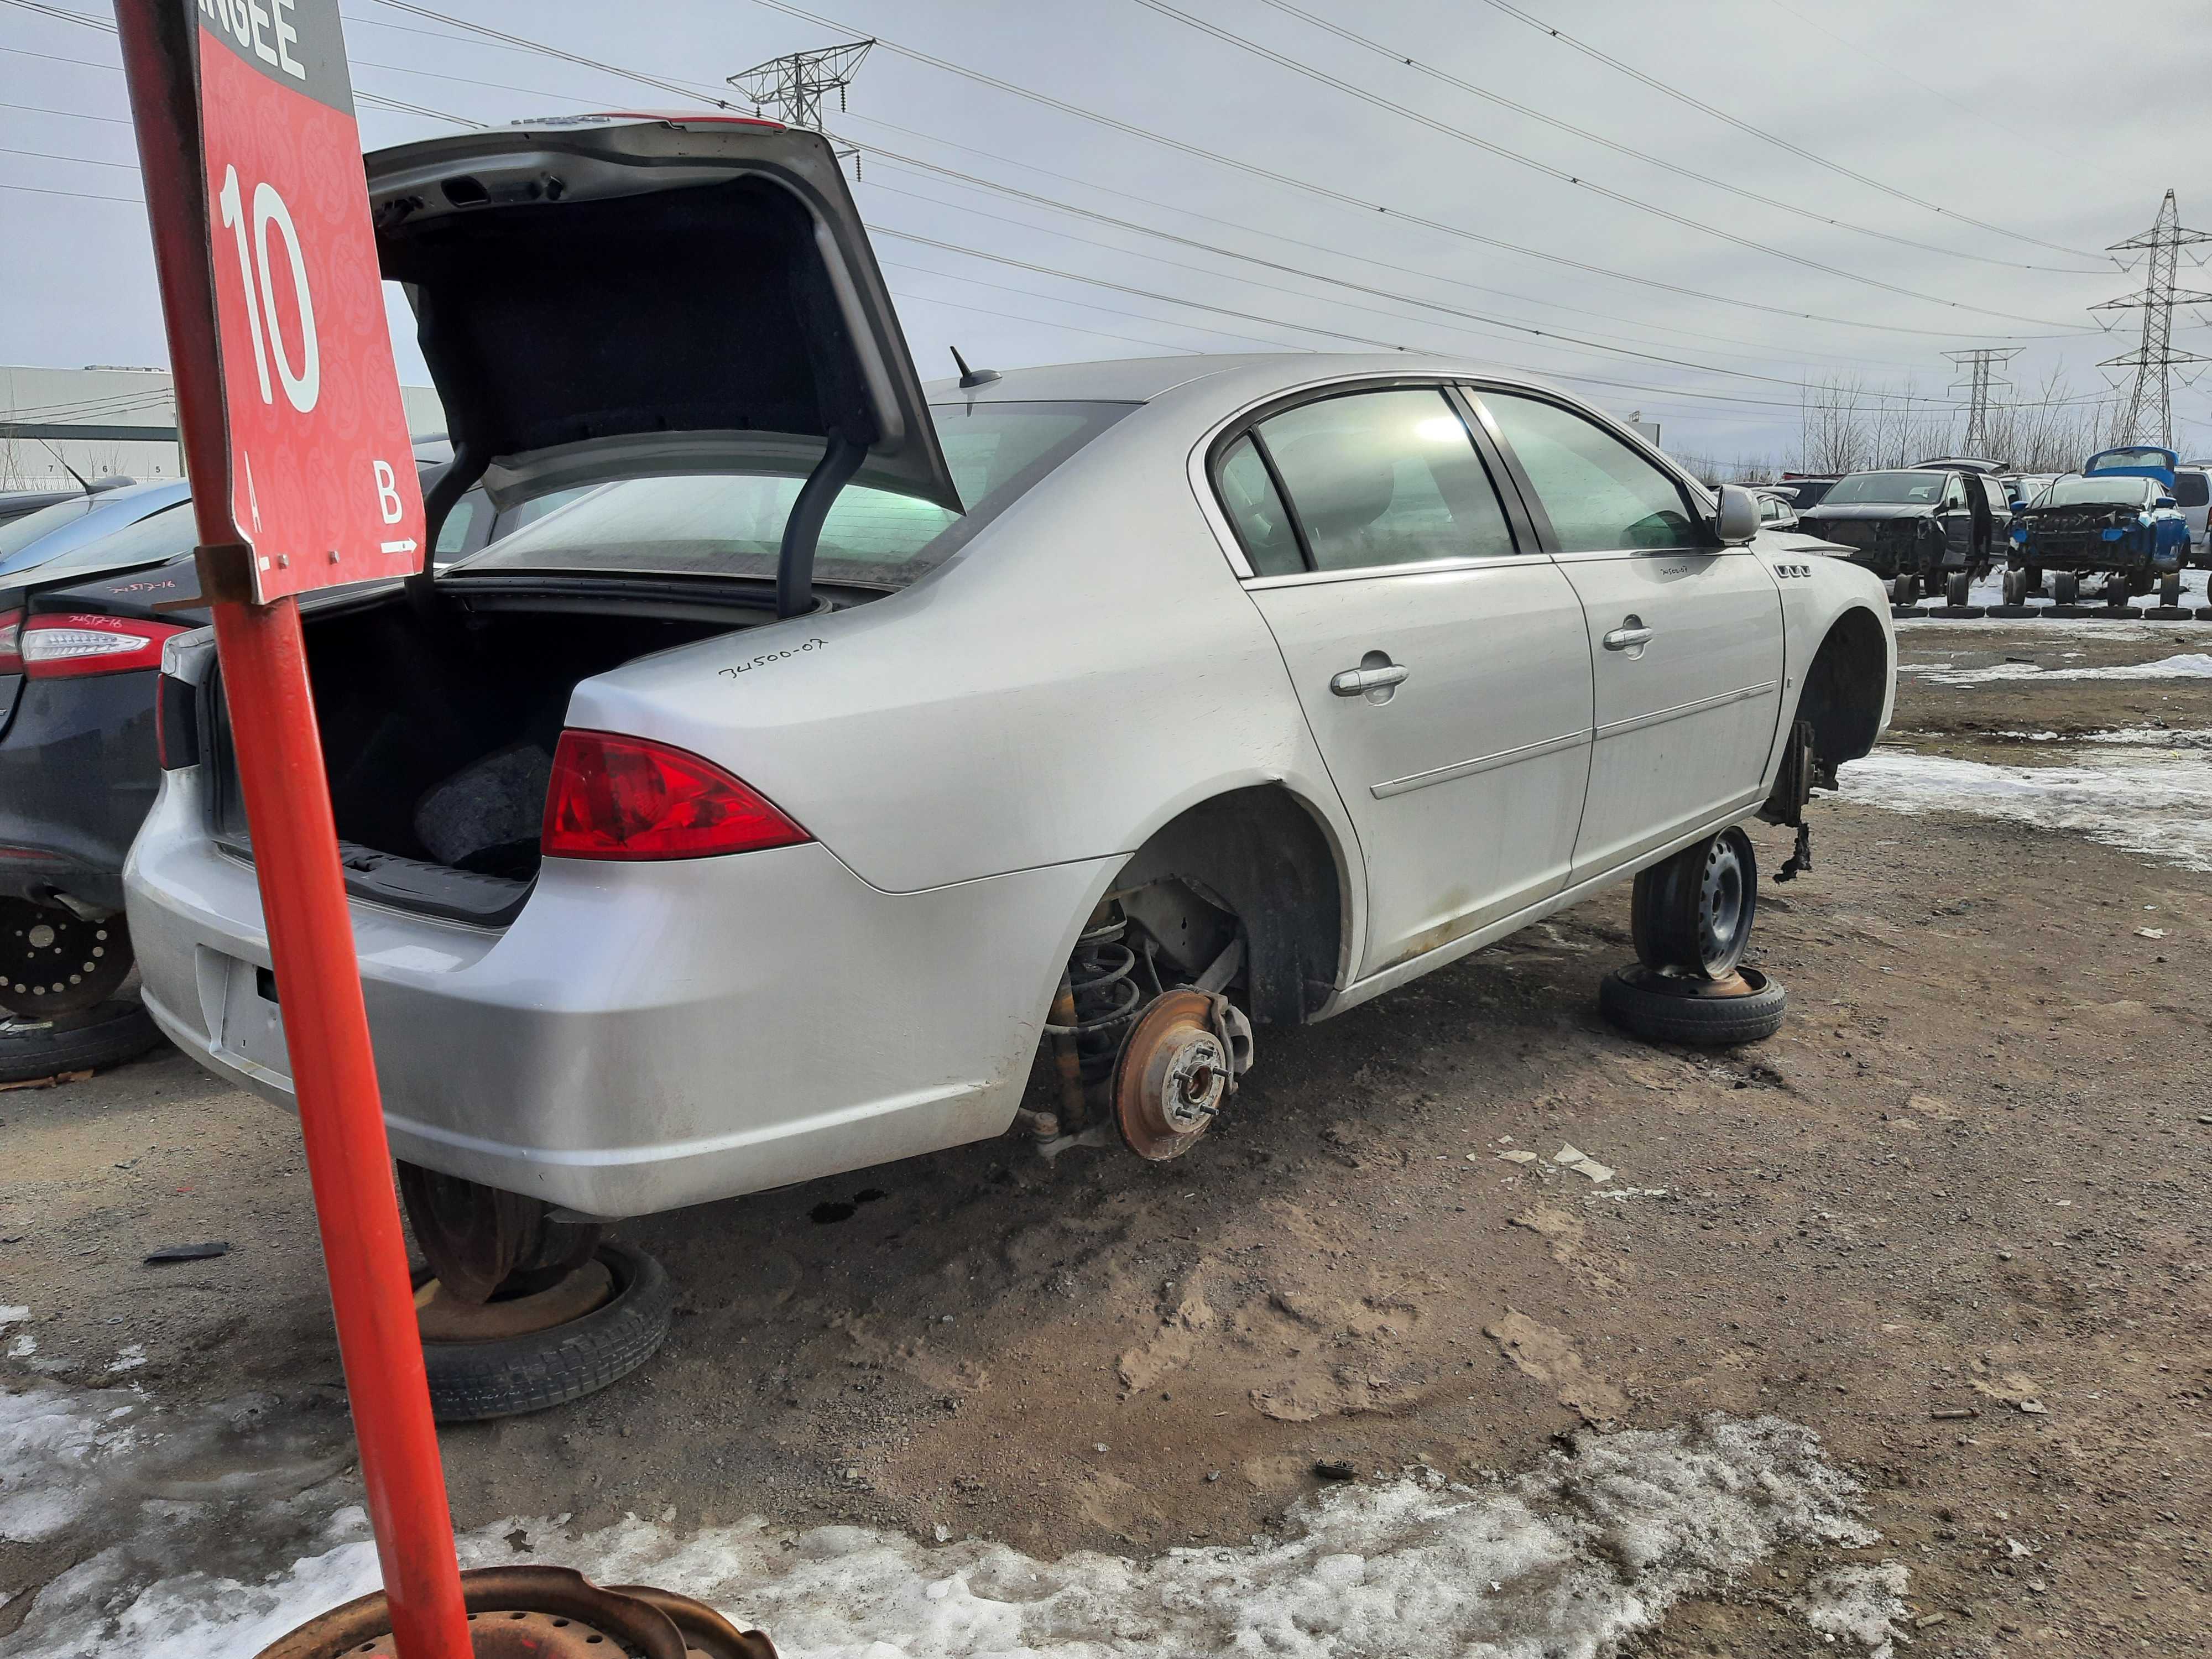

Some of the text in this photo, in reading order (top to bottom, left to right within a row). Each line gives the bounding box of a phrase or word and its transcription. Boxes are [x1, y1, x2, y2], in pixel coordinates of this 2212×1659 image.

[220, 163, 320, 413] 10
[373, 460, 403, 524] B
[718, 638, 828, 679] 34500-07
